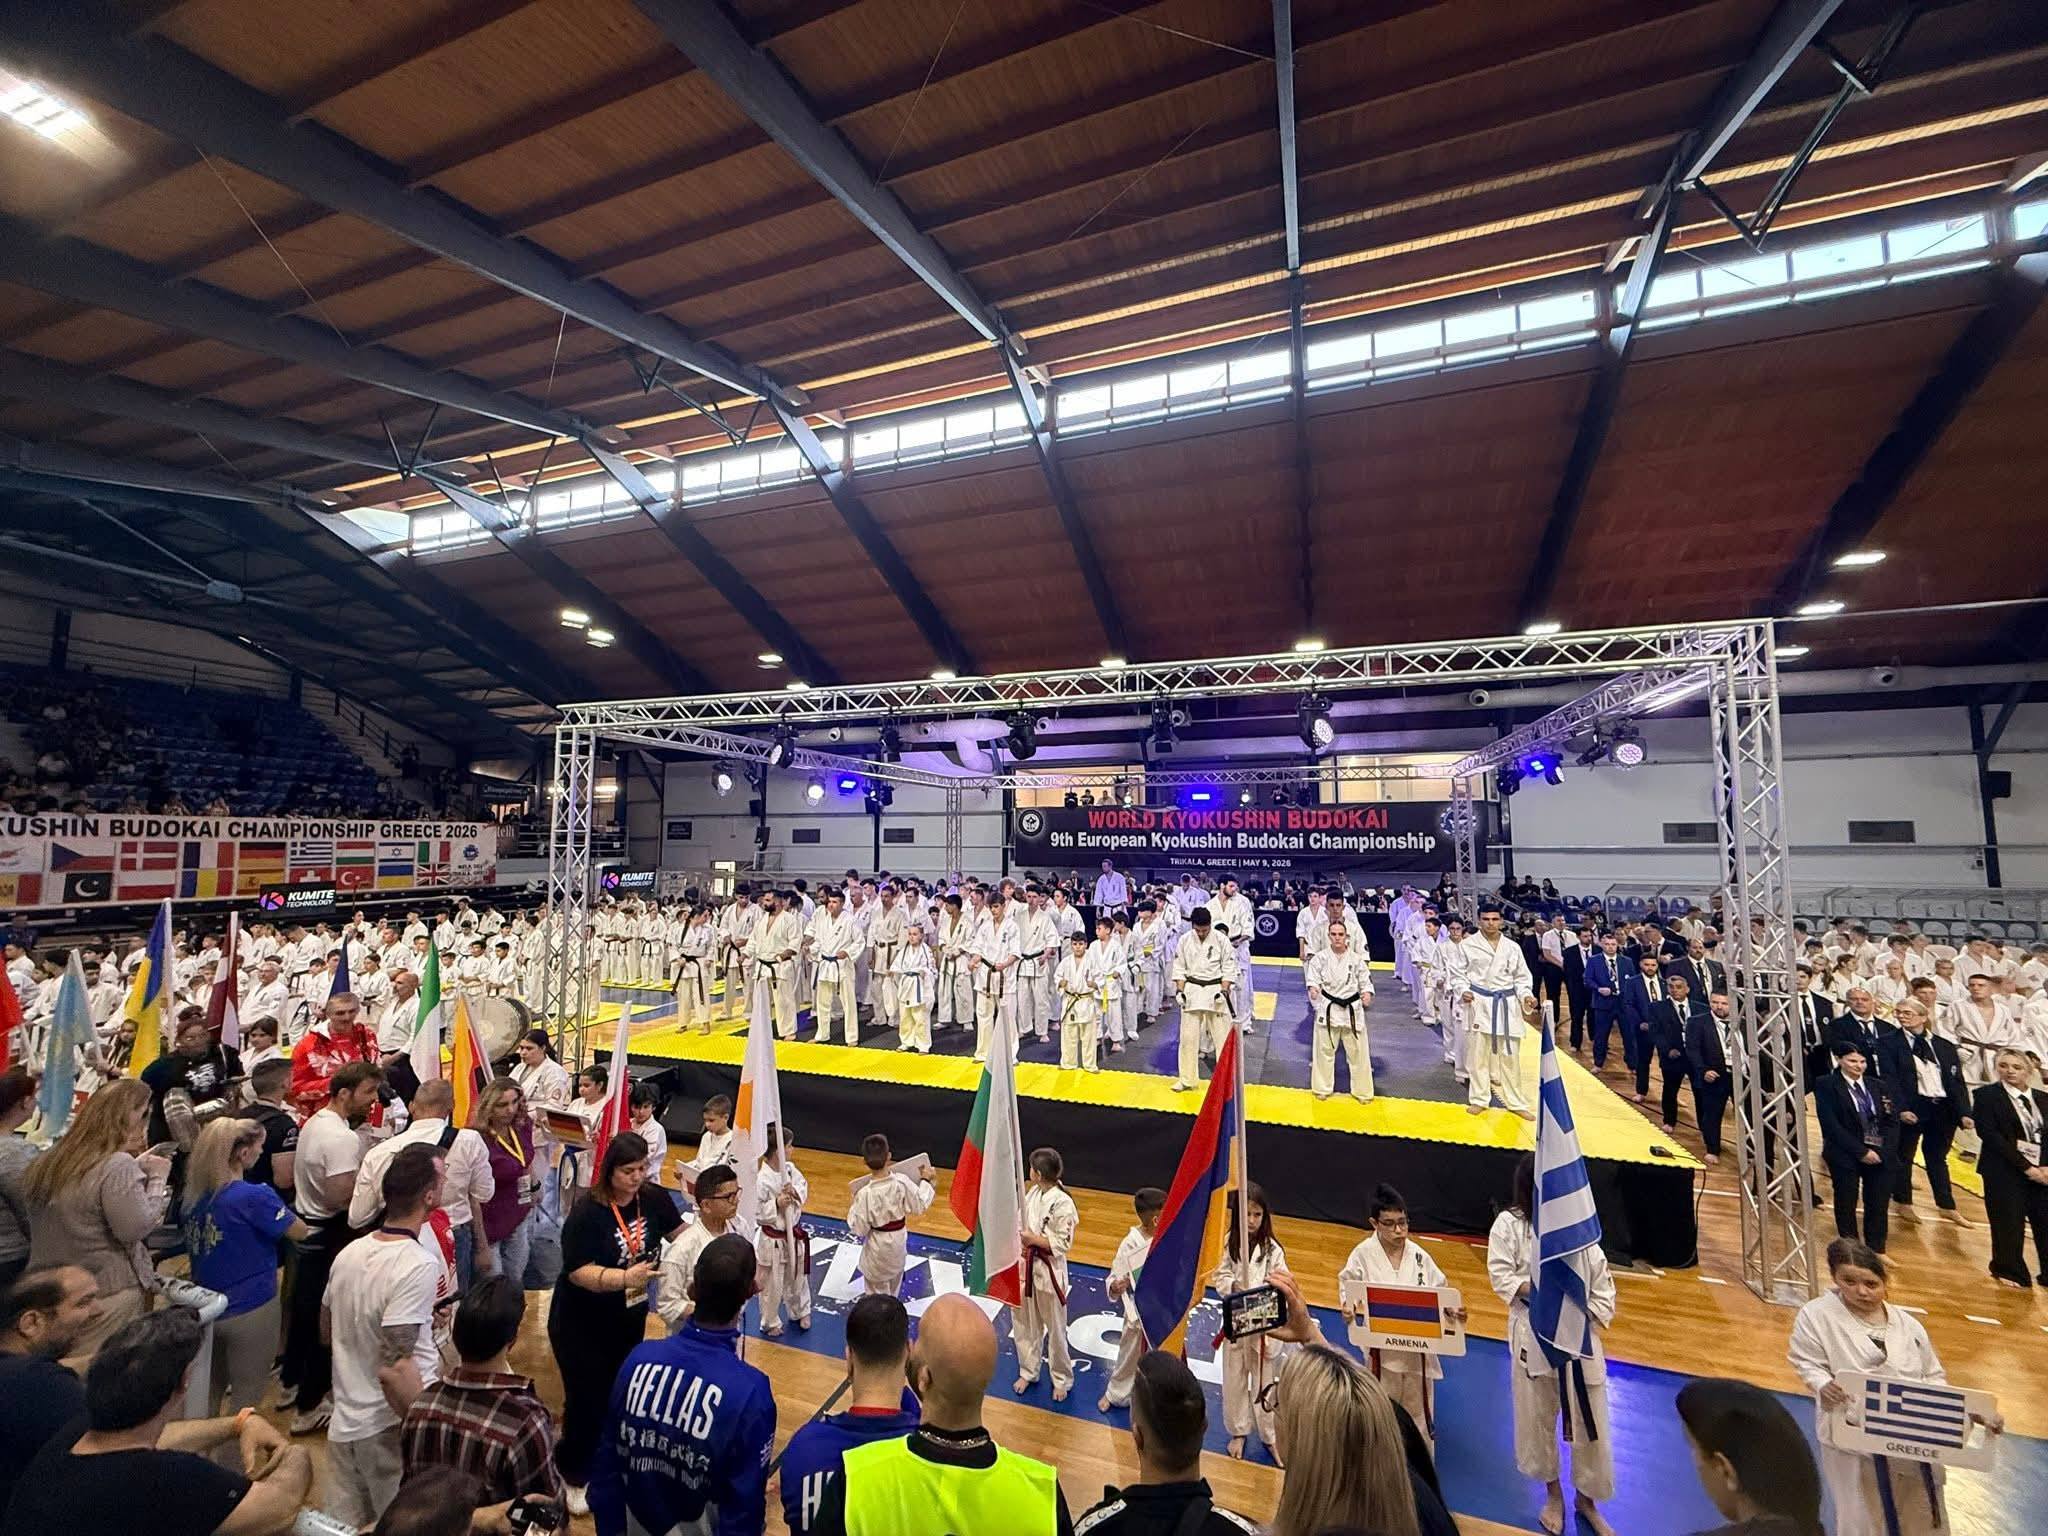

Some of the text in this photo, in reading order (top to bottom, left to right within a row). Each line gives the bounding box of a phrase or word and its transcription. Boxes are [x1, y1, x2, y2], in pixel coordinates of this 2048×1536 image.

[1088, 809, 1388, 829] WORLD KYOKUSHIN BUDOKAI
[0, 817, 99, 837] USHIN
[109, 819, 220, 838] BUDOKAI
[228, 821, 375, 839] CHAMPIONSHIP
[380, 824, 441, 839] GREECE
[446, 824, 477, 839] 2026
[1050, 832, 1436, 853] 9th European Kyokushin Budokai Championship
[1170, 857, 1205, 866] TRIKALA,
[1206, 858, 1237, 867] GREECE
[1243, 859, 1261, 867] MAY
[1262, 859, 1270, 868] 9,
[1271, 859, 1292, 868] 2026
[621, 871, 655, 881] KUMITE
[288, 889, 336, 900] KUMITE
[286, 899, 334, 909] TECHNOLOGY
[1385, 1337, 1429, 1349] ARMENIA
[625, 1363, 723, 1440] HELLAS
[1886, 1442, 1940, 1459] GREECE
